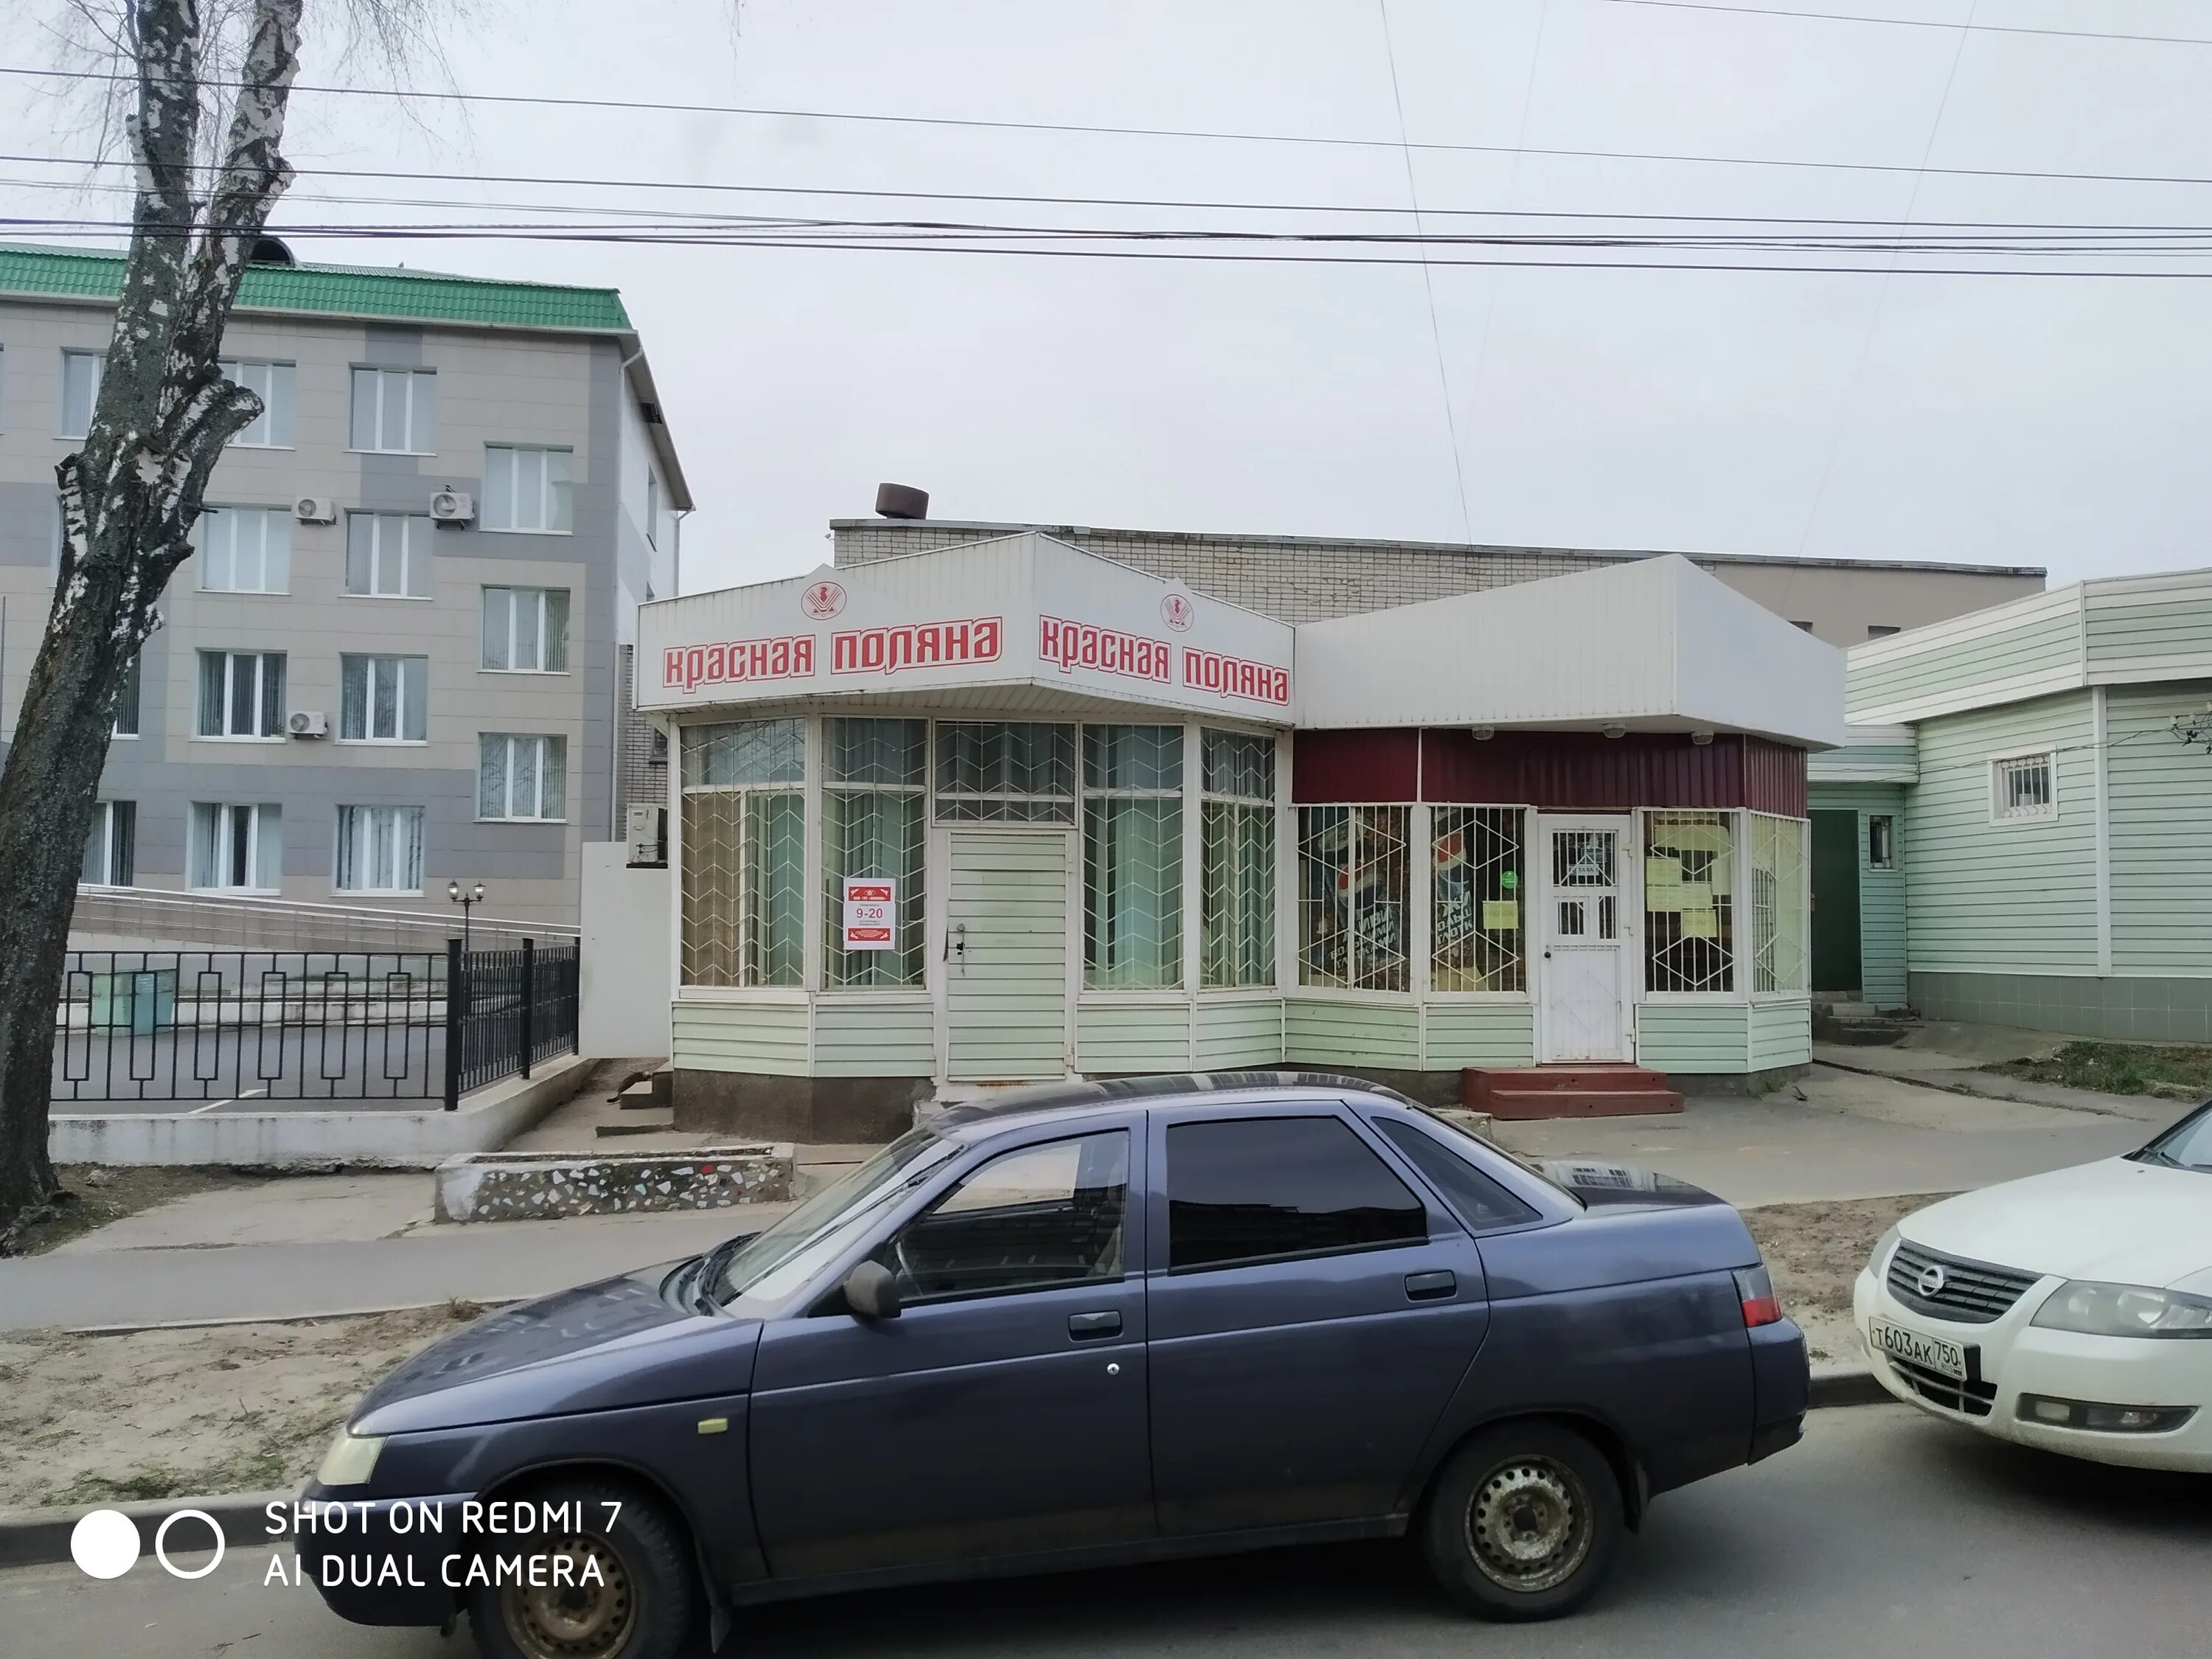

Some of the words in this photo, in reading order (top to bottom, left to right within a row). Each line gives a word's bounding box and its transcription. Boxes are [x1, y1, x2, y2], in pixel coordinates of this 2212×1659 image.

[856, 908, 883, 919] 9-20
[1329, 920, 1394, 961] БОЬШИМИ
[1335, 932, 1396, 970] ГЛТКАМИ
[1875, 1326, 1933, 1365] Т603АК
[1933, 1340, 1958, 1366] 750
[1941, 1362, 1954, 1371] RUS
